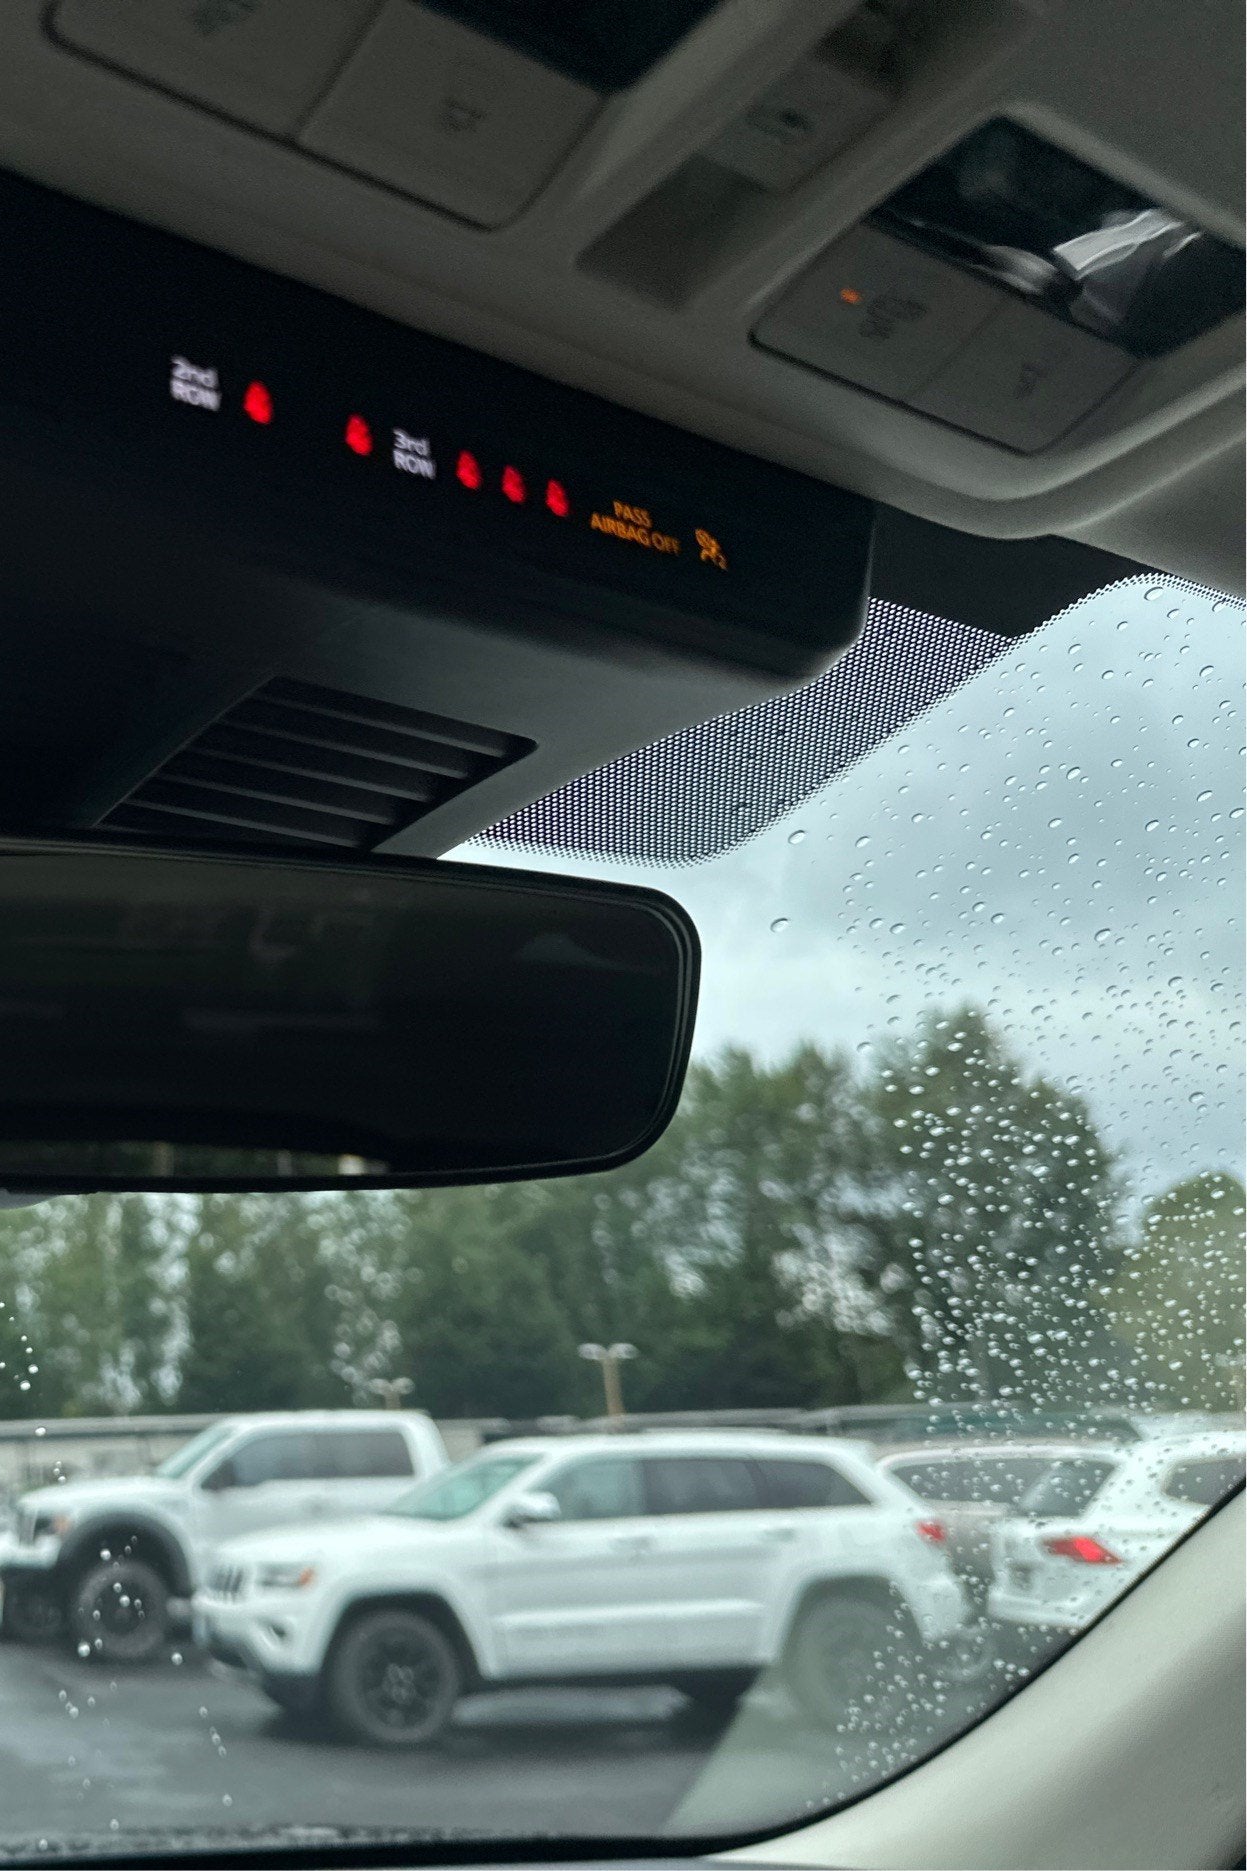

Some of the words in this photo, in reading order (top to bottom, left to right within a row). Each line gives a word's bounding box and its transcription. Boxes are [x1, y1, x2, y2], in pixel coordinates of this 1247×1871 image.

[172, 356, 218, 388] 2nd
[171, 380, 221, 411] ROW
[393, 428, 429, 457] 3rd
[393, 449, 435, 480] ROW
[613, 500, 652, 528] PASS
[590, 512, 651, 548] AIRBAG
[651, 531, 680, 554] OFF
